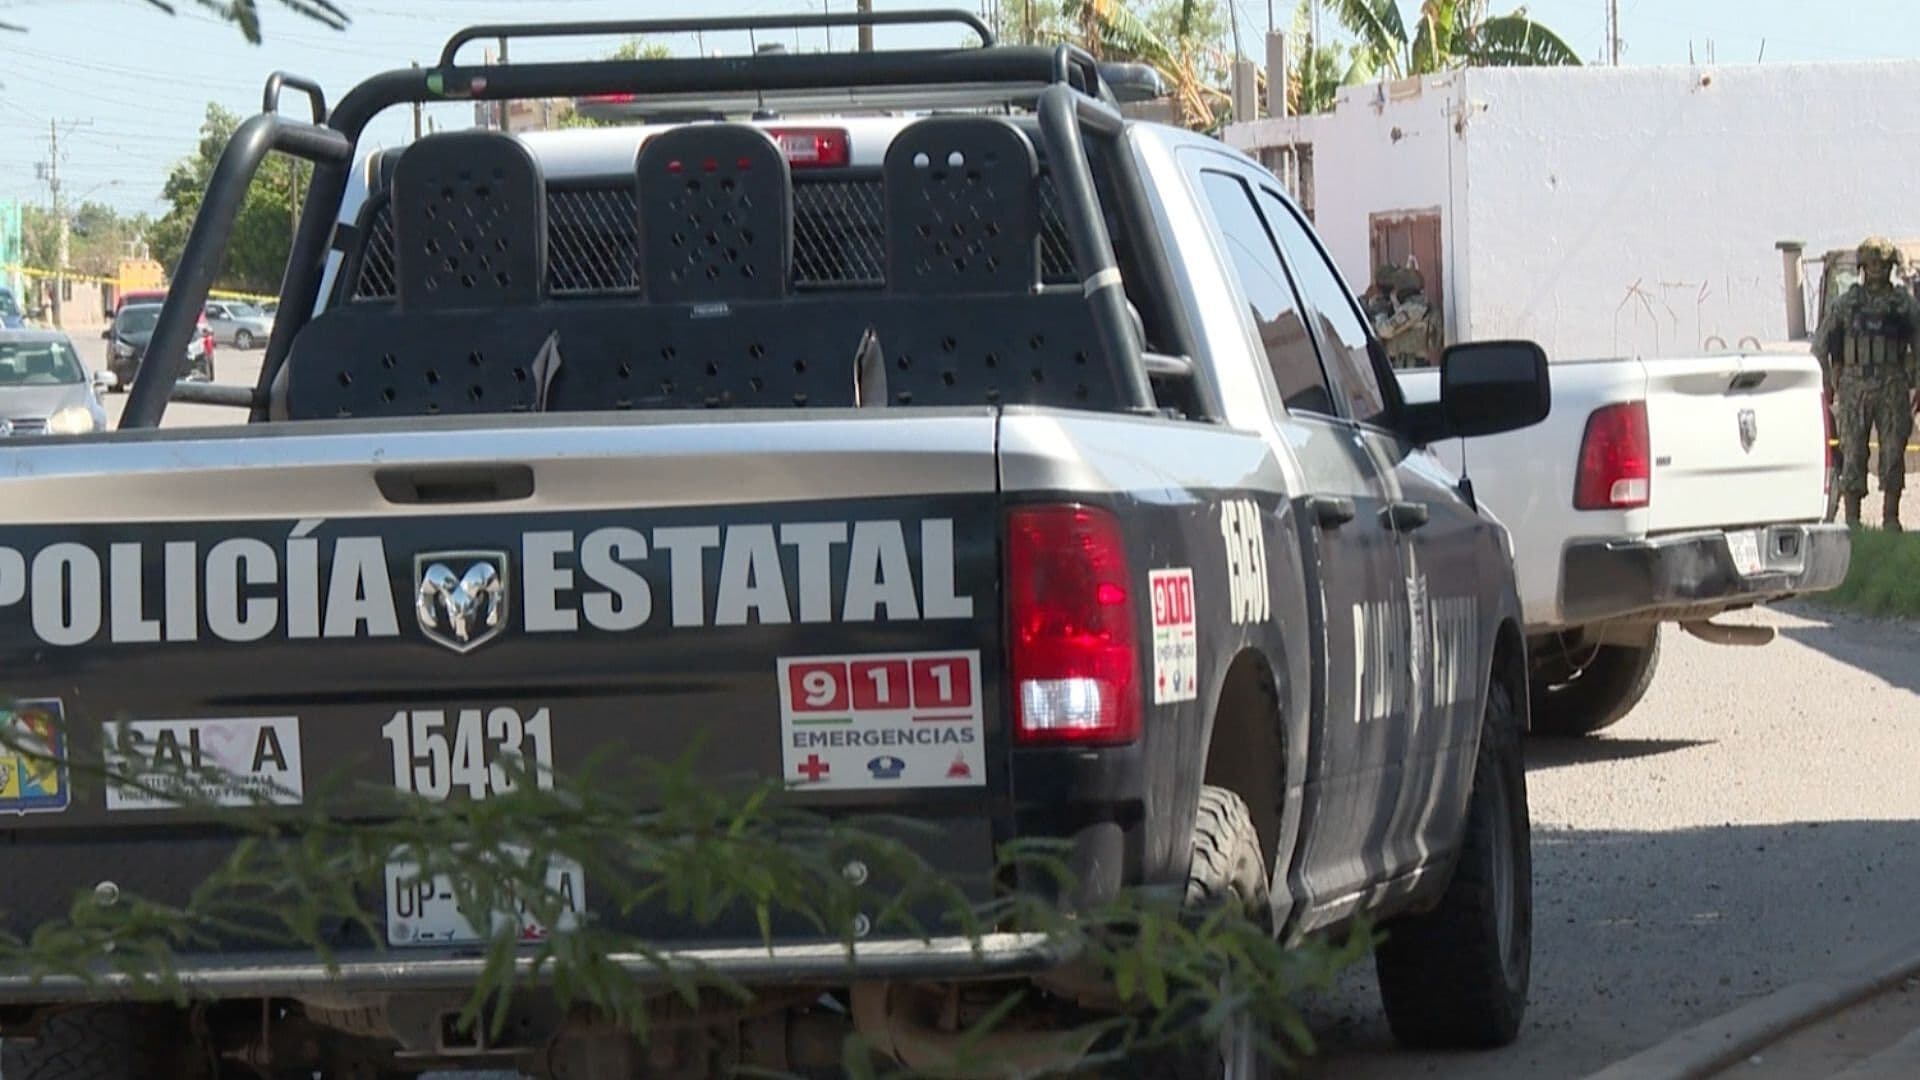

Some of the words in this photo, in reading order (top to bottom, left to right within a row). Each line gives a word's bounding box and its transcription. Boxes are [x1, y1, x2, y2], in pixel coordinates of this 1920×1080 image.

[522, 517, 974, 633] ESTATAL
[1155, 579, 1193, 624] 911
[802, 664, 953, 707] 911
[382, 706, 555, 801] 15431
[793, 726, 976, 749] EMERGENCIAS
